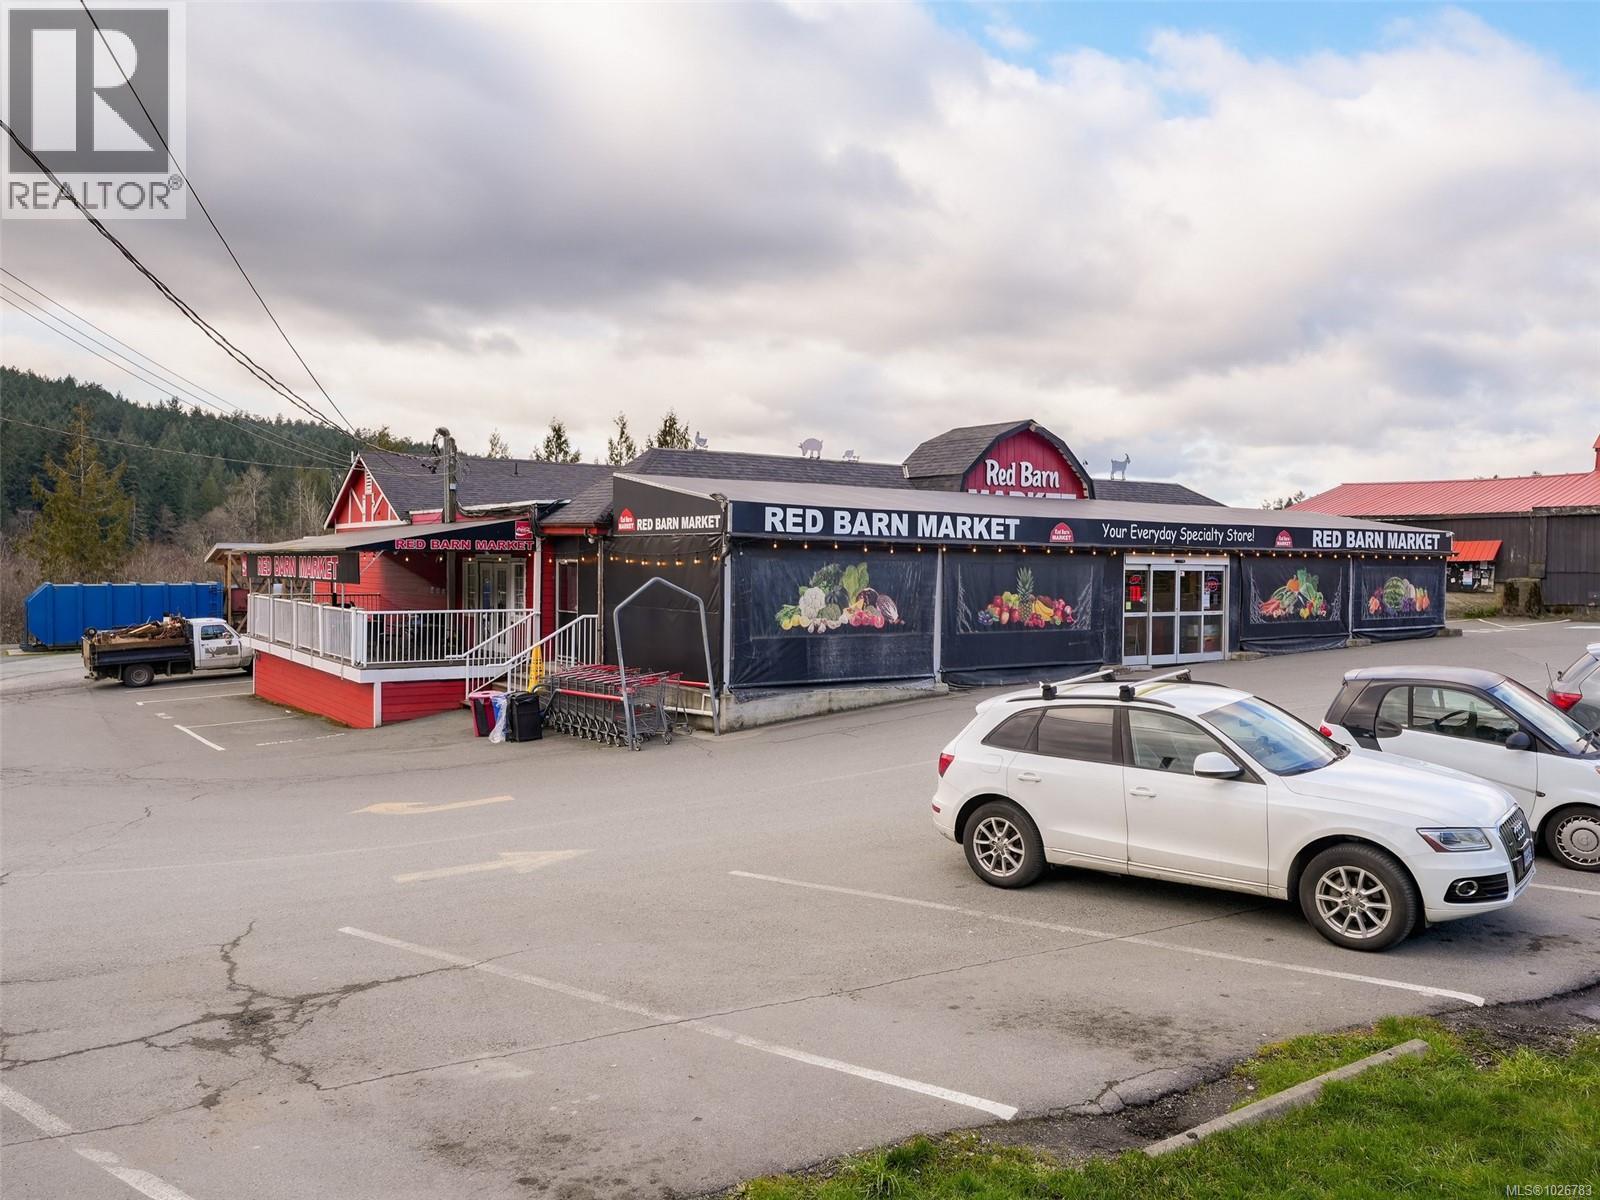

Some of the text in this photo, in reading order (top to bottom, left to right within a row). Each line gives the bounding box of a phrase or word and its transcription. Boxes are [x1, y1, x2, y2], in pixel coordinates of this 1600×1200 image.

[985, 459, 1060, 488] Red Barn
[637, 514, 720, 531] RED BARN MARKET
[764, 506, 1020, 541] RED BARN MARKET
[394, 538, 534, 551] RED BARN MARKET
[1102, 523, 1255, 545] Your Everyday Specialty Store!
[1312, 530, 1441, 550] RED BARN MARKET
[257, 555, 272, 576] RED
[274, 555, 297, 578] BARN
[299, 555, 338, 580] MARKET
